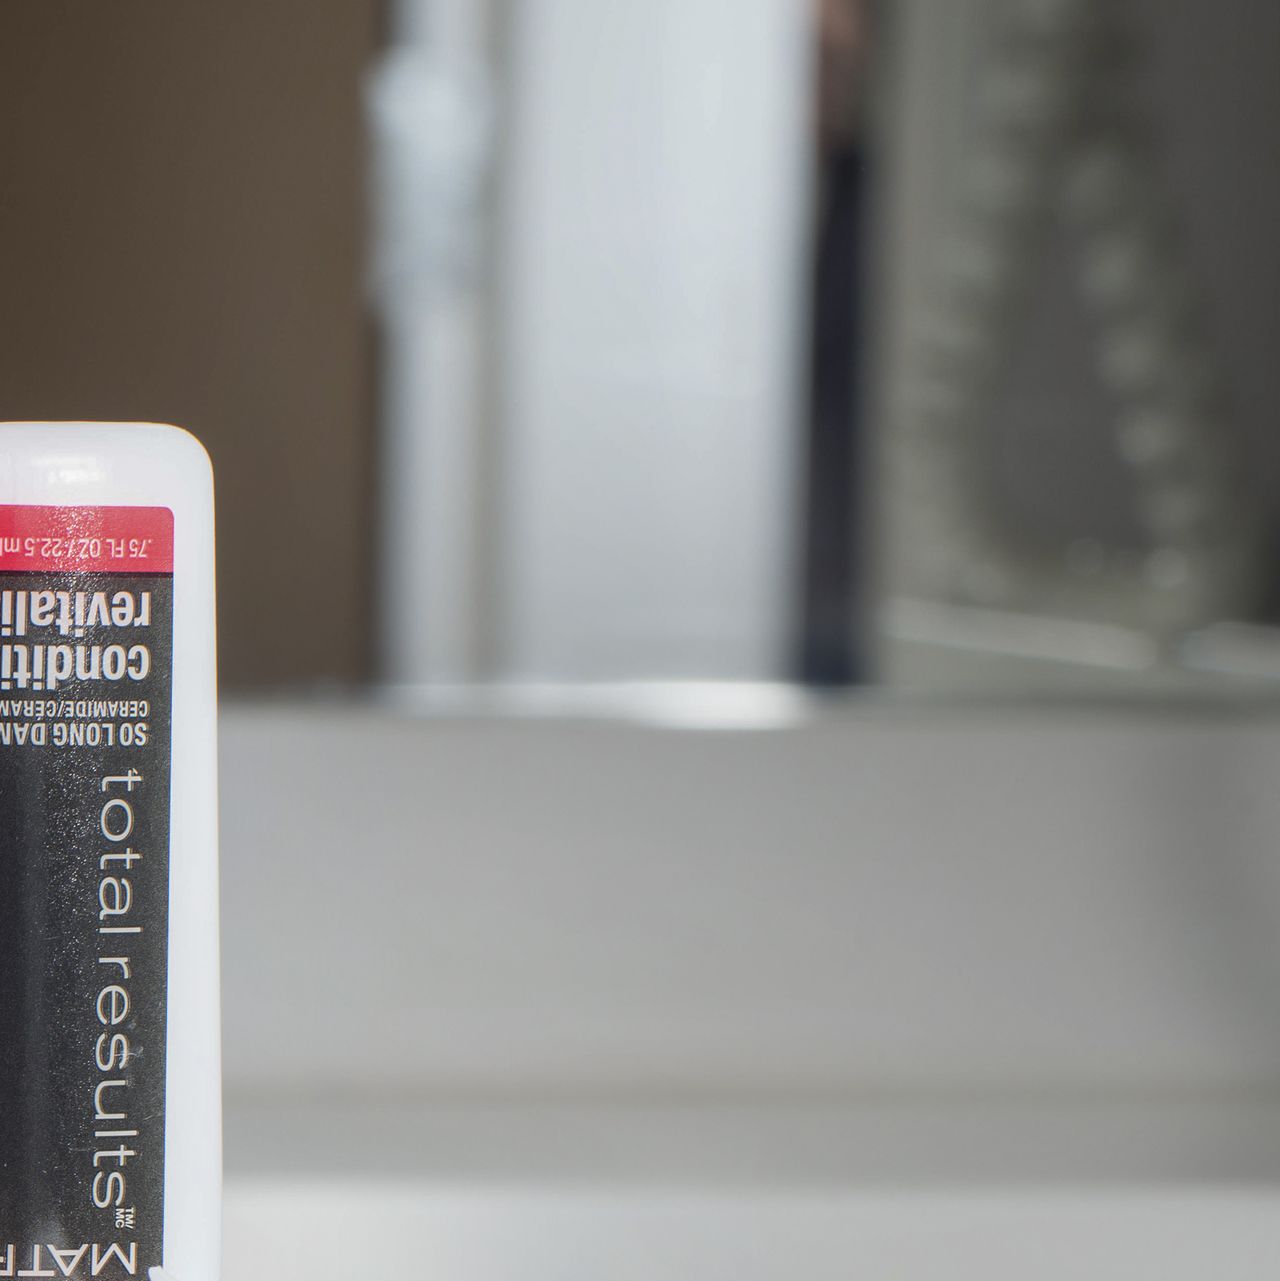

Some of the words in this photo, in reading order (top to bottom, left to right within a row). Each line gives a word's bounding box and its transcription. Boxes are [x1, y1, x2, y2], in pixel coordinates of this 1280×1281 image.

[24, 537, 62, 557] 22.5
[77, 538, 102, 558] OZ
[106, 538, 125, 558] FL
[128, 538, 153, 559] .75
[53, 721, 115, 746] LONG
[119, 722, 148, 746] SO
[98, 767, 143, 934] total
[92, 956, 138, 1209] results
